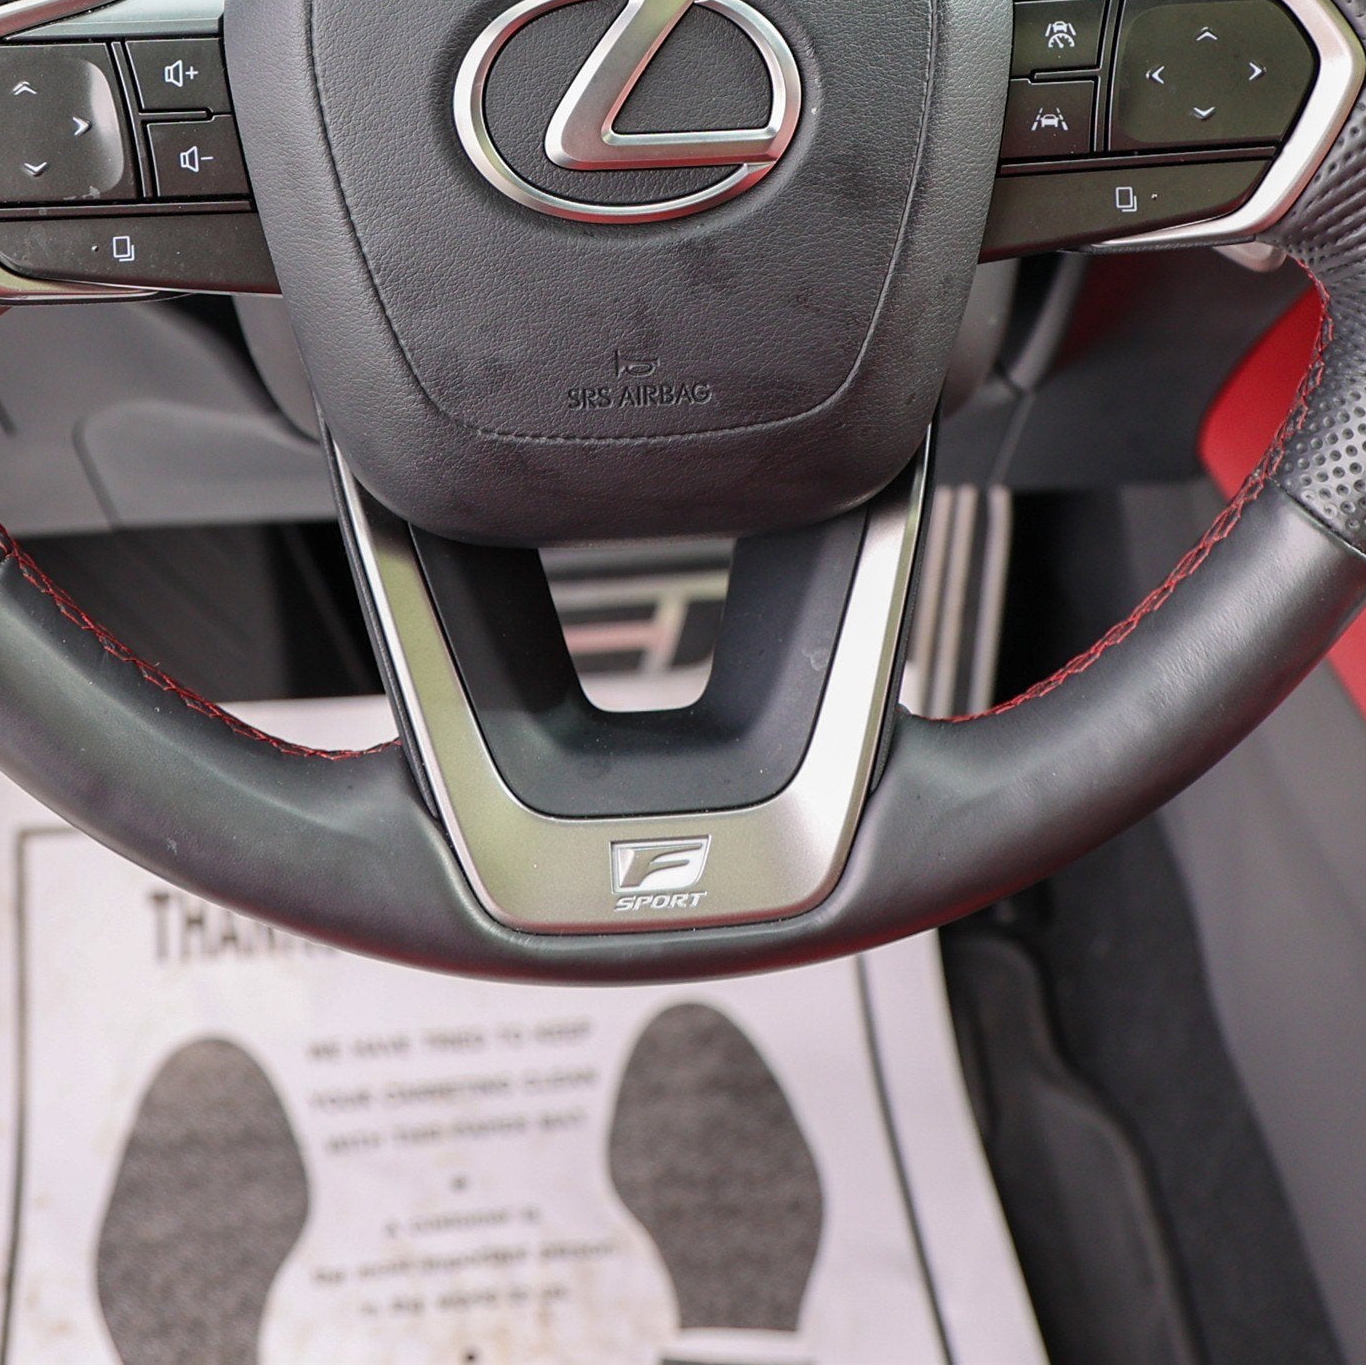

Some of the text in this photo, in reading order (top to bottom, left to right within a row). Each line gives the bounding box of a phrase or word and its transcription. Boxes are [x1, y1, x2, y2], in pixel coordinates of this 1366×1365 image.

[567, 381, 712, 410] SRS AIRBAG
[614, 891, 707, 912] SPORT
